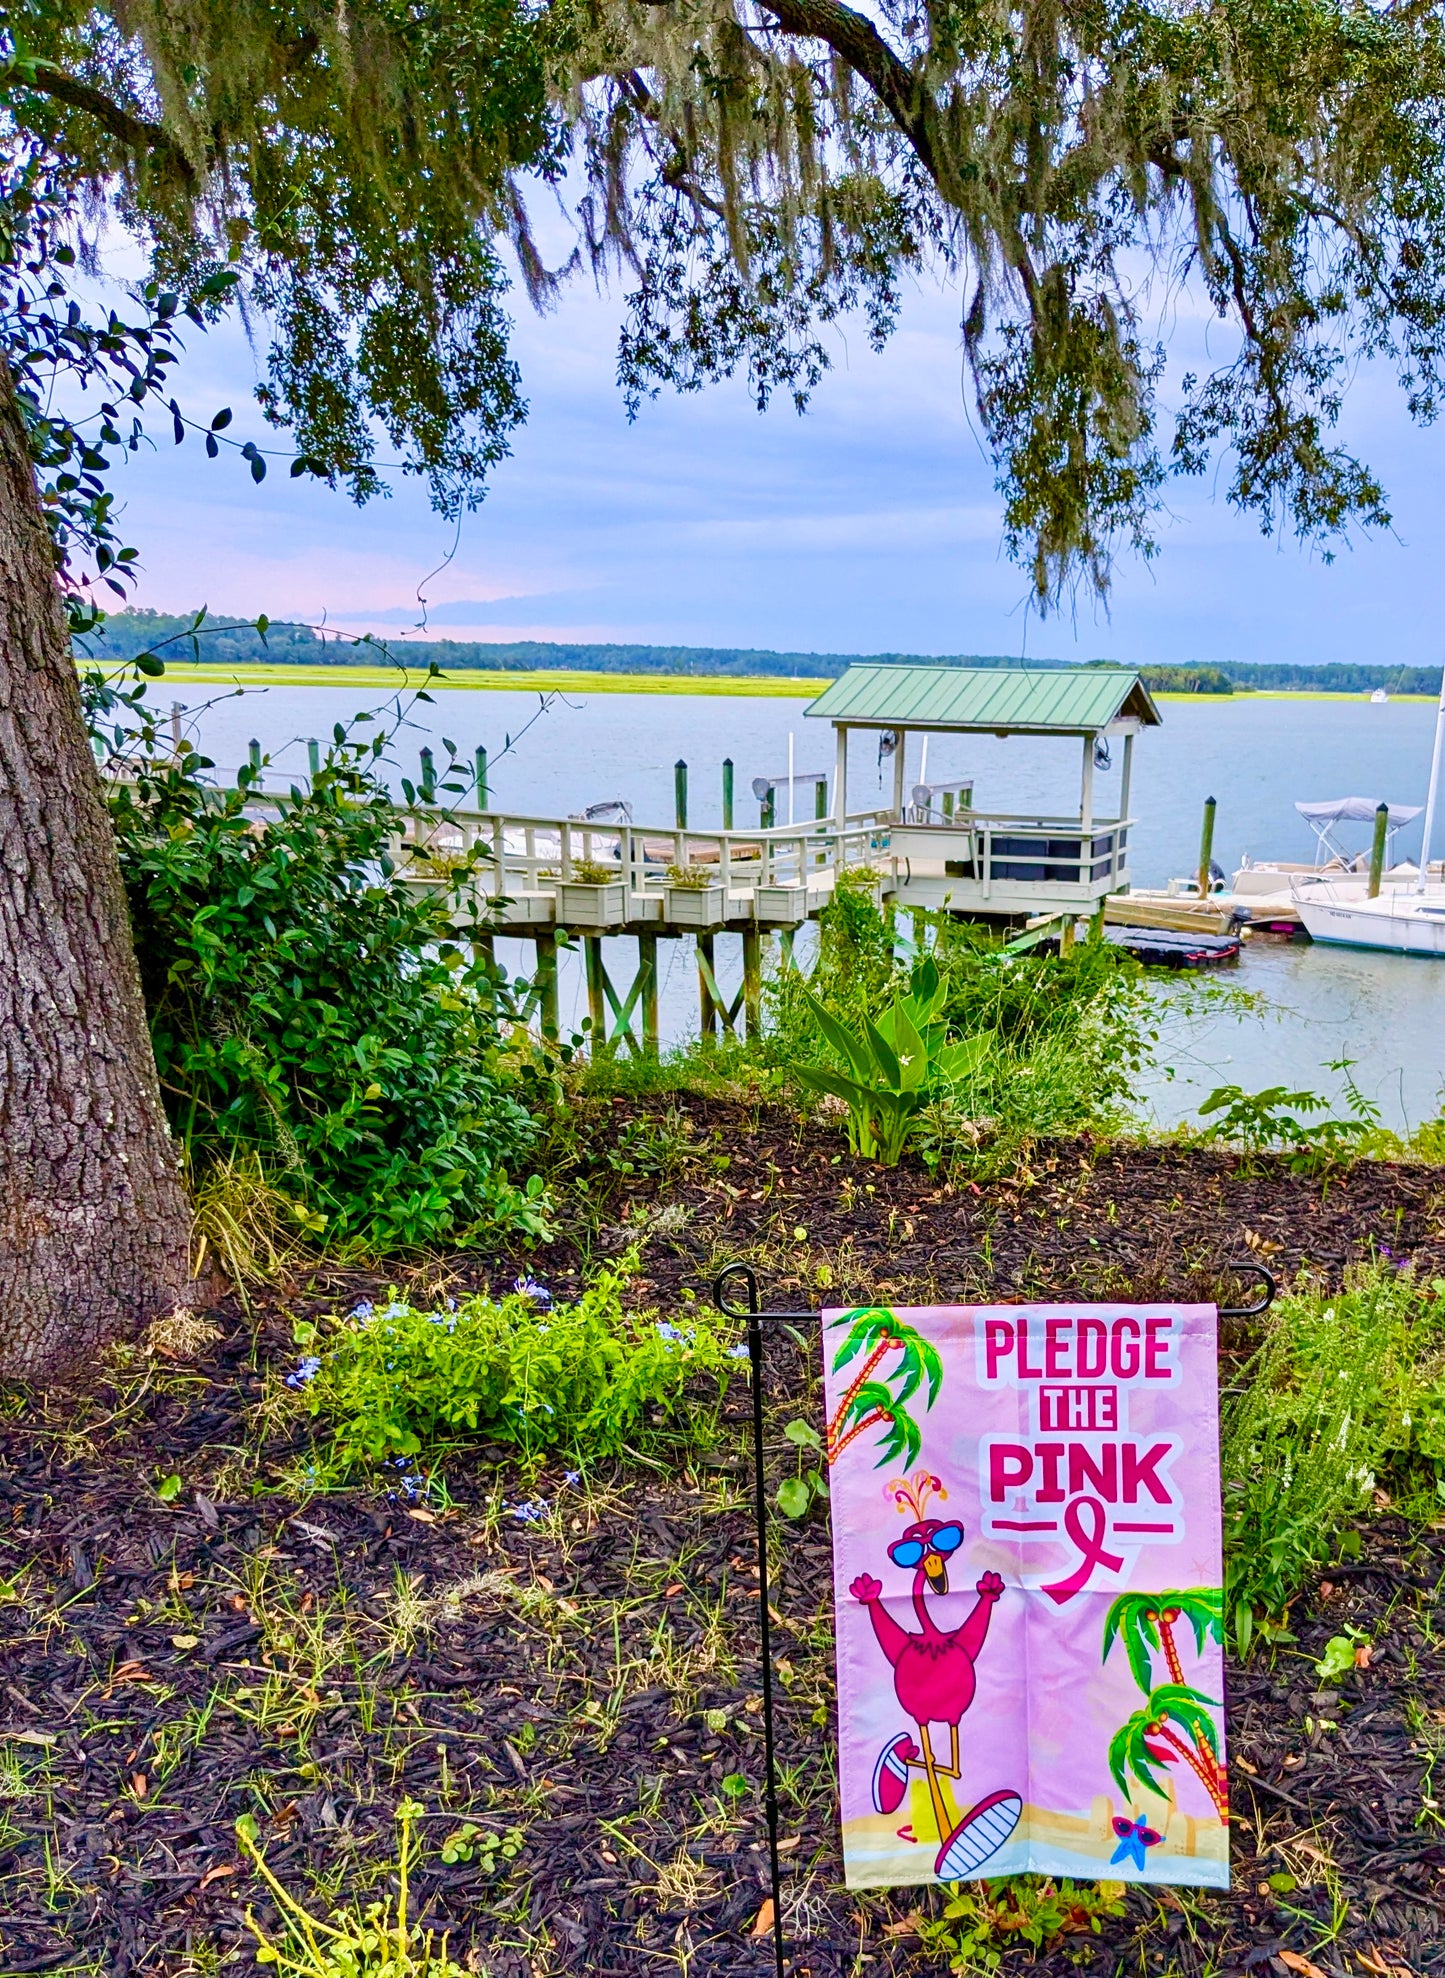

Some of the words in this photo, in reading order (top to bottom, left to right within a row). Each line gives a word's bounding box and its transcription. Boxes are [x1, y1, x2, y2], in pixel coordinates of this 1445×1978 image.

[985, 1318, 1172, 1378] PLEDGE
[1043, 1389, 1114, 1428] THE
[989, 1443, 1172, 1504] PINK
